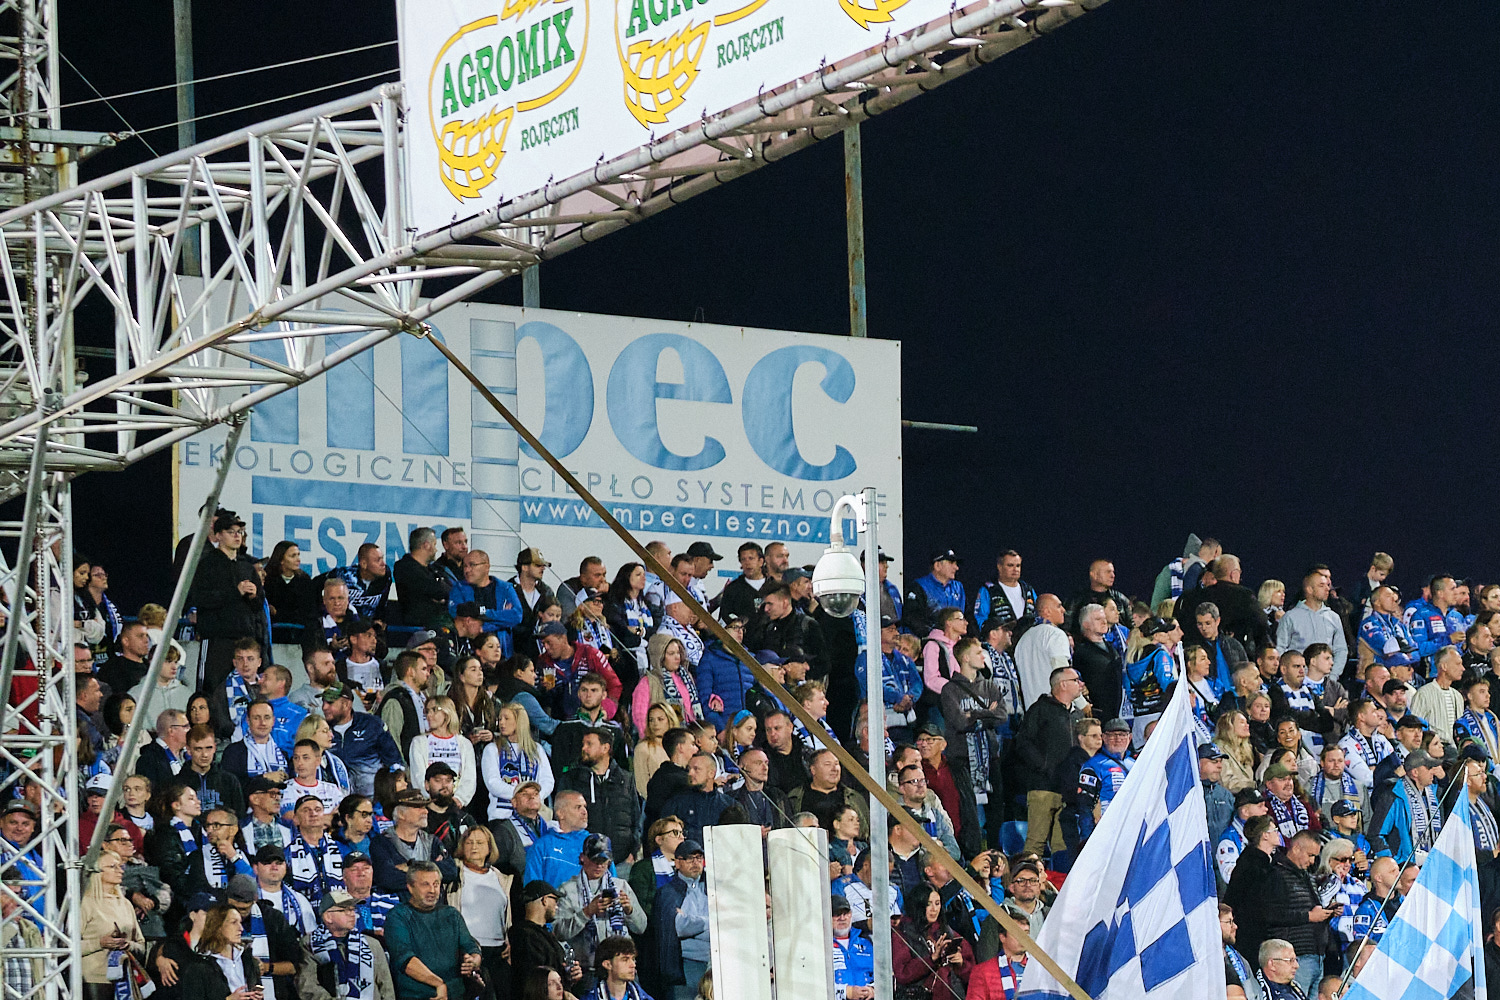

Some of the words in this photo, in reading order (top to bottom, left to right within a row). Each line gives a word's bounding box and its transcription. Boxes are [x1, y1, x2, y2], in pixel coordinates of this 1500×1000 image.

[440, 6, 576, 119] AGROMIX
[717, 16, 785, 69] ROJĘCZYN
[520, 106, 580, 151] ROJĘCZYN
[184, 440, 468, 487] EKOLOGICZNE
[676, 478, 888, 518] SYSTEMOE
[523, 499, 857, 542] wwwmpec.leszno.l
[360, 935, 375, 969] 2007
